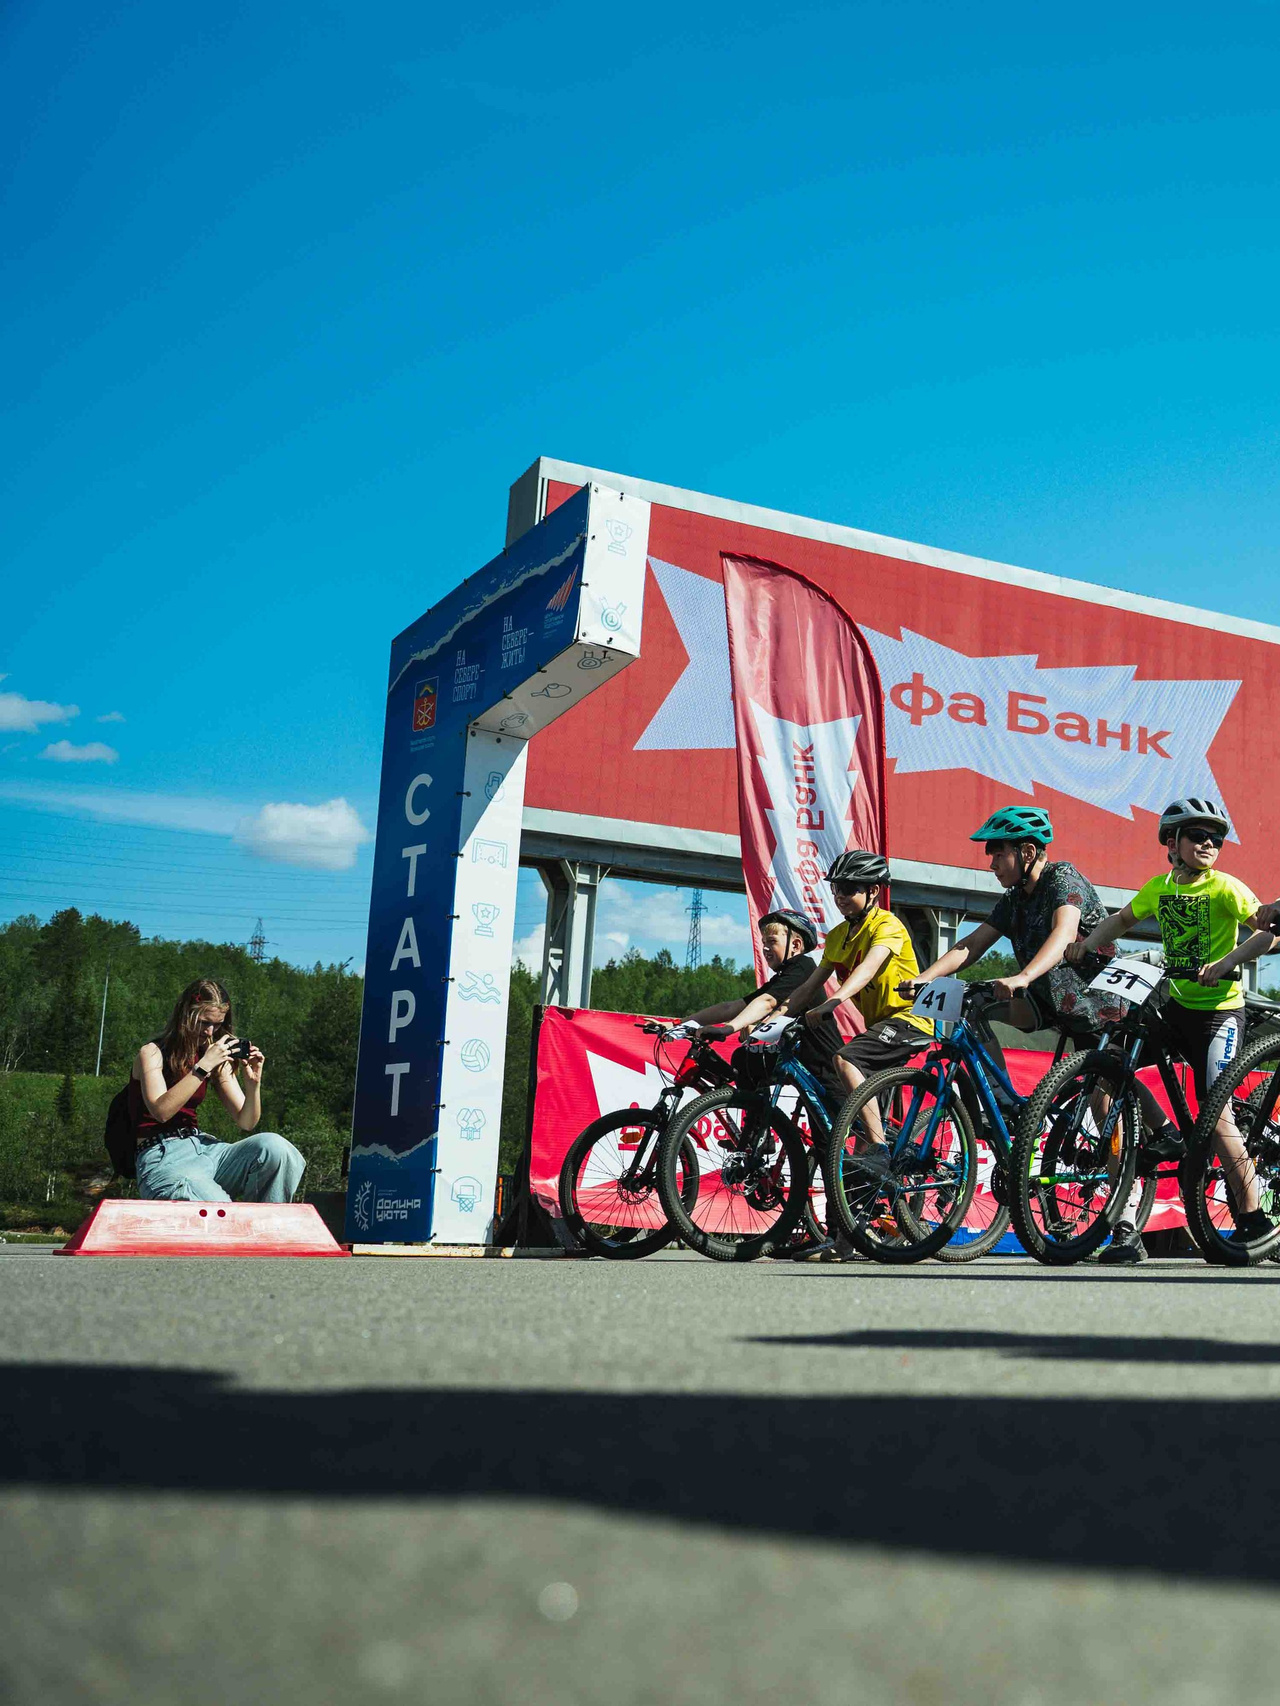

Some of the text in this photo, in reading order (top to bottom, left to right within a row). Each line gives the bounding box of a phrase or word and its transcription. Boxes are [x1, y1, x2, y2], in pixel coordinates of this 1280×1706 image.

[503, 615, 513, 633] НА
[456, 649, 466, 667] НА
[500, 647, 526, 669] ЖИТЬ!
[889, 671, 1174, 760] фа Банк
[384, 773, 434, 1118] СТАРТ
[1106, 969, 1140, 990] 51
[921, 989, 948, 1011] 41
[1132, 1107, 1140, 1148] PATROL
